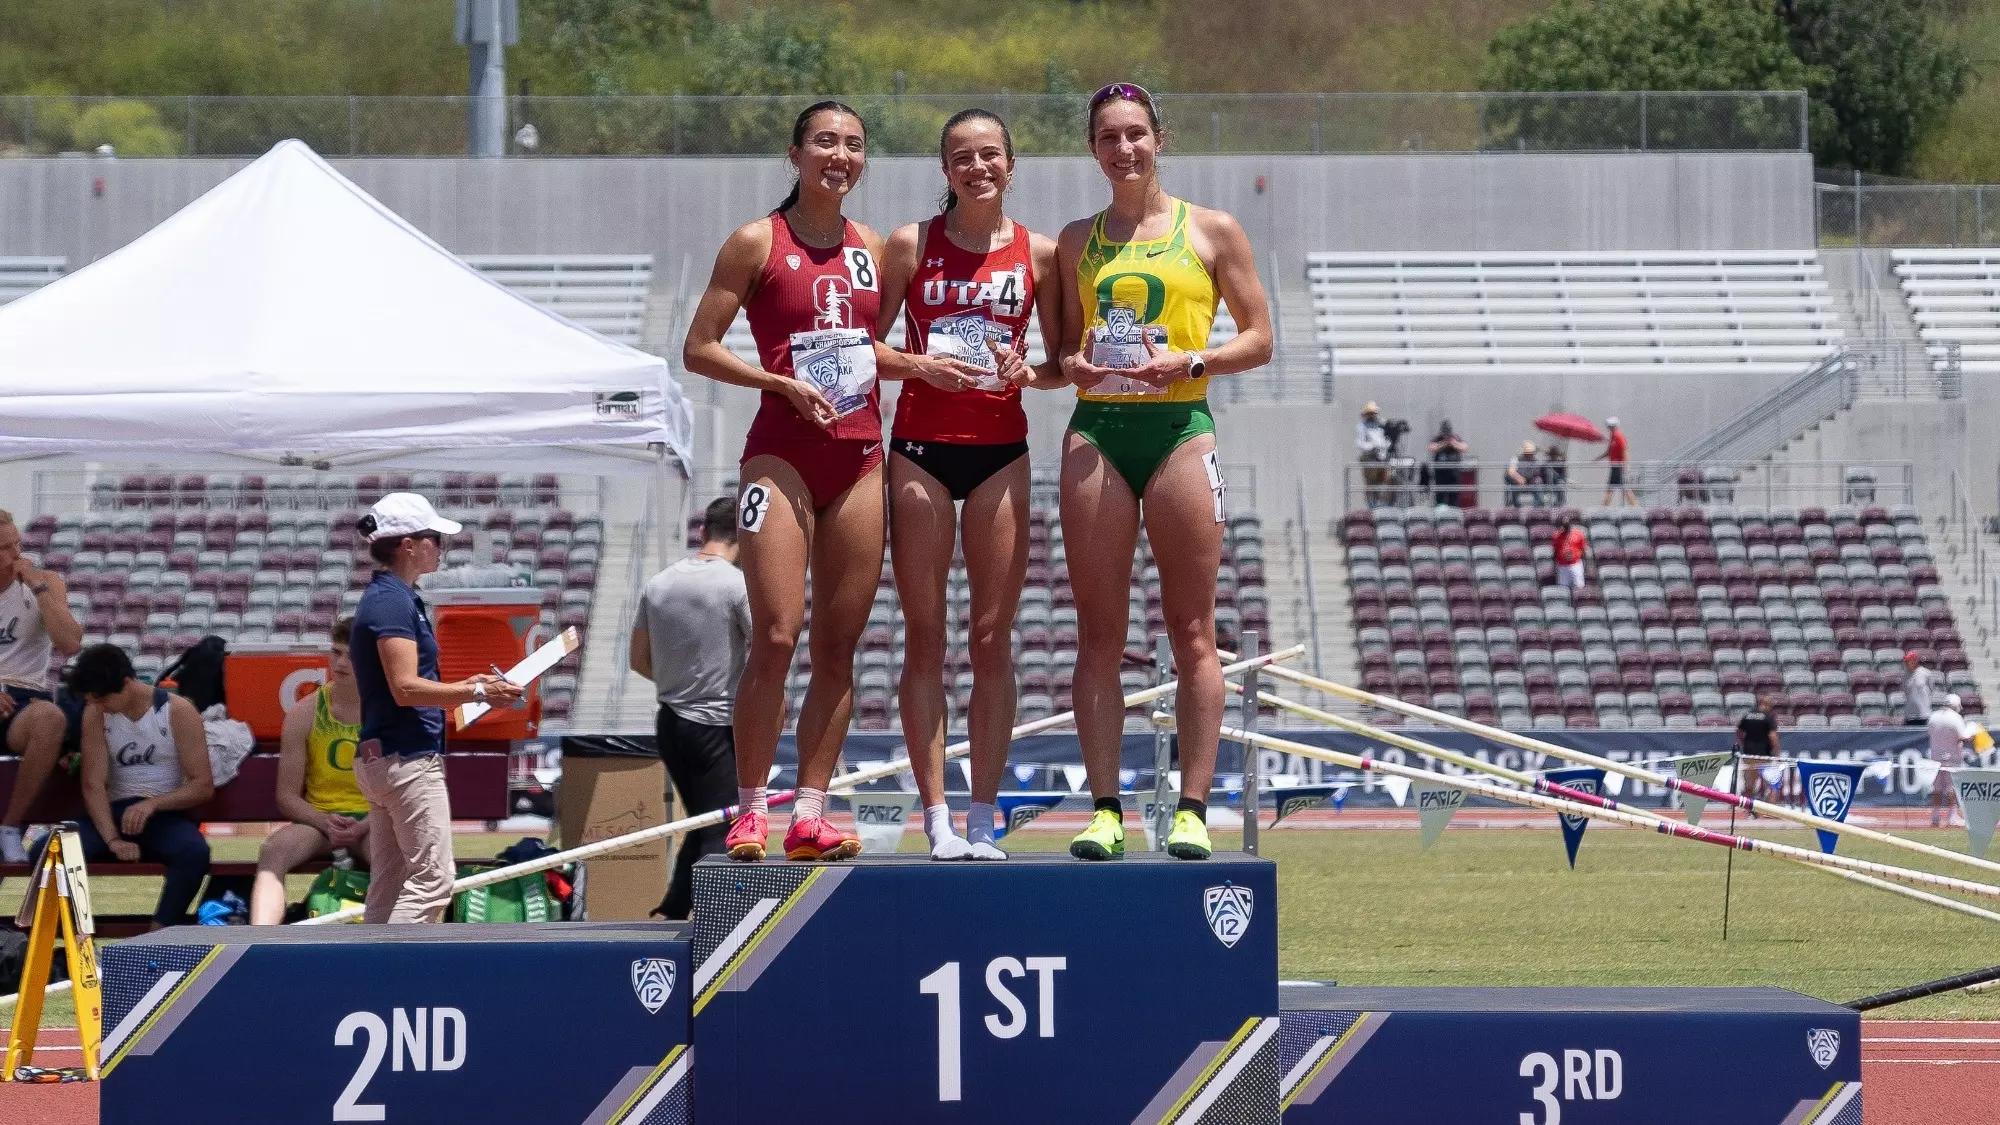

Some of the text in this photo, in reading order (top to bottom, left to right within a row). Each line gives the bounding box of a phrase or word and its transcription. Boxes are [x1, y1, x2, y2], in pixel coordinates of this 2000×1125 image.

[852, 250, 873, 288] 8
[924, 281, 1000, 305] UTA
[999, 274, 1019, 314] 4
[1097, 272, 1166, 325] O
[969, 333, 981, 343] 12
[1115, 325, 1125, 334] 12
[823, 373, 835, 384] 12
[742, 486, 765, 528] 8
[115, 741, 156, 767] Cal
[1813, 776, 1848, 802] PAC
[1821, 799, 1838, 815] 12
[1206, 888, 1251, 926] PAC
[1220, 918, 1240, 936] 12
[634, 960, 674, 992] PAC
[645, 987, 663, 1003] 12
[919, 956, 1067, 1102] 1ST
[332, 1007, 467, 1122] 2ND
[1818, 1050, 1832, 1062] 12
[1518, 1048, 1624, 1125] 3RD
